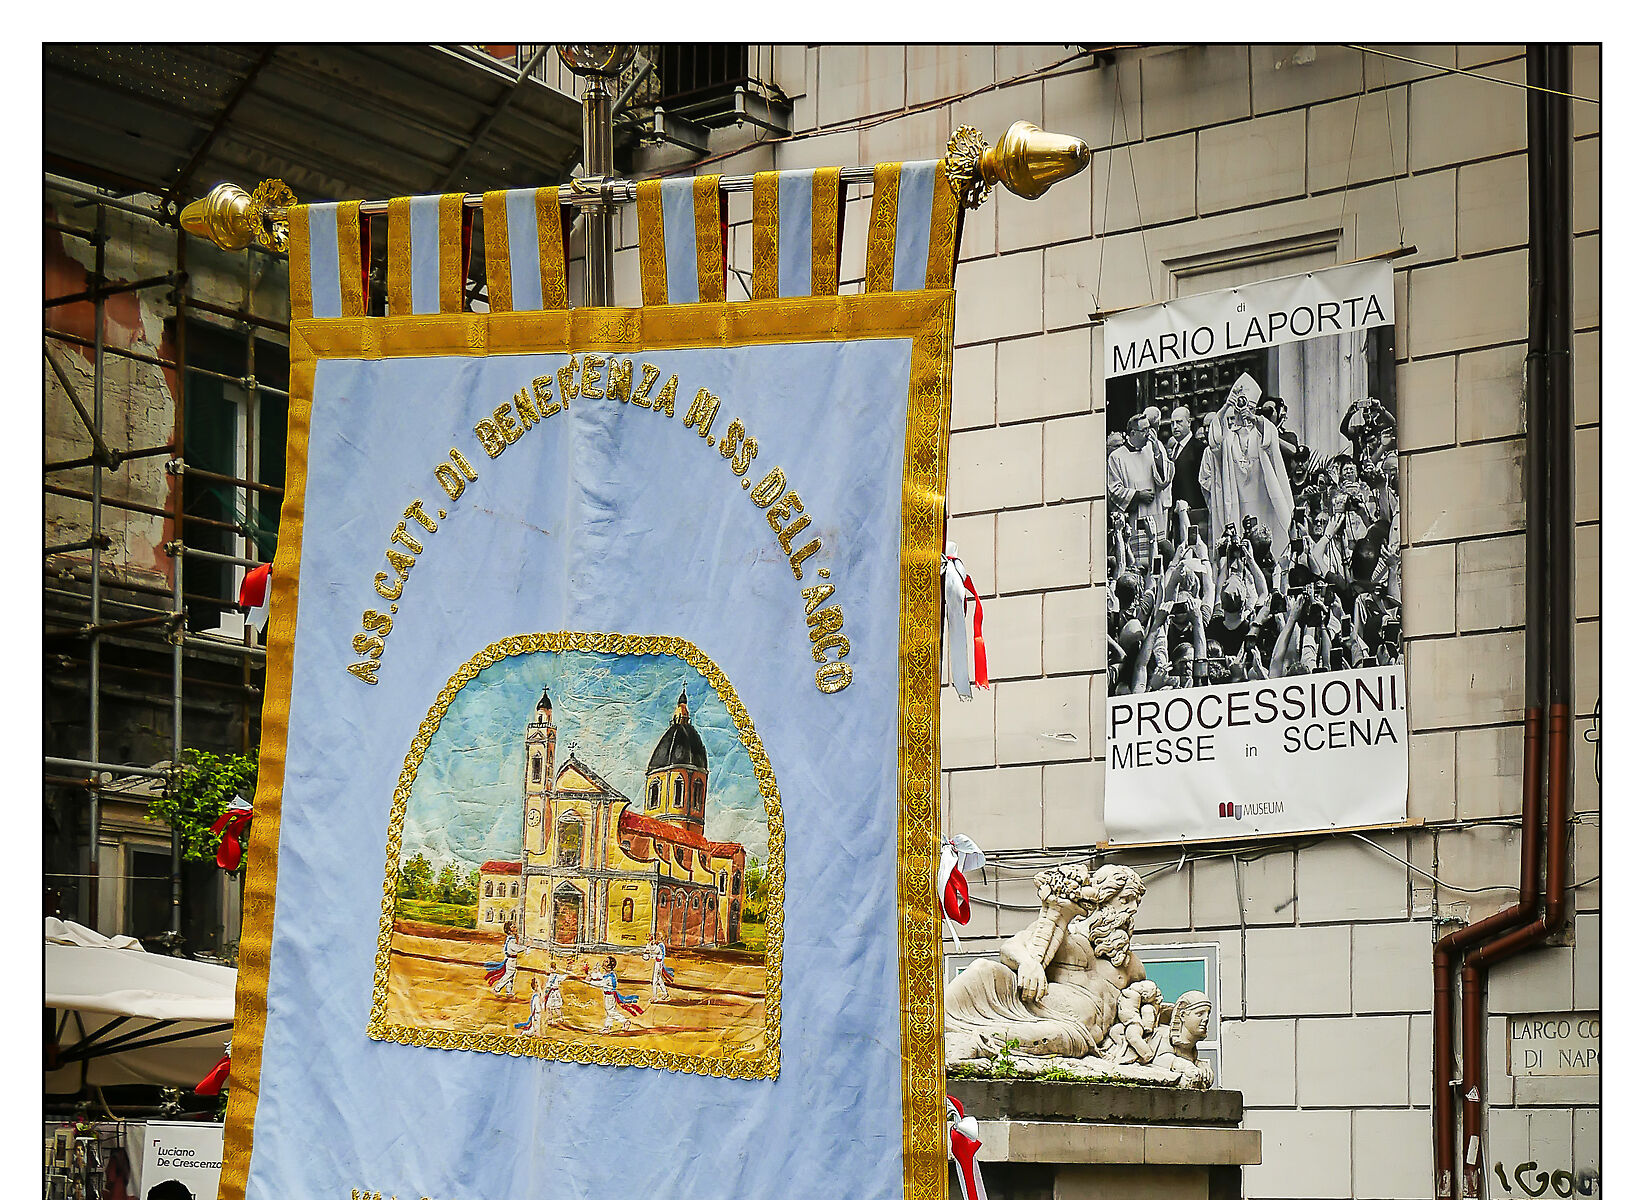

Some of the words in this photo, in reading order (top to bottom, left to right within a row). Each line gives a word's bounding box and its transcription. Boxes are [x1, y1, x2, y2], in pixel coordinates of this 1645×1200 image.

[1236, 302, 1246, 313] di
[1113, 326, 1215, 373] MARIO
[1226, 294, 1386, 350] LAPORTA
[1111, 674, 1398, 739] PROCESSIONI
[1111, 734, 1216, 770] MESSE
[1245, 743, 1258, 758] in
[1283, 717, 1399, 754] SCENA
[1244, 801, 1285, 816] MUSEUM
[1512, 1021, 1571, 1040] LARGO
[1525, 1049, 1542, 1068] DI
[1559, 1048, 1599, 1068] NAP
[158, 1147, 195, 1157] Luciano
[157, 1158, 170, 1167] De
[172, 1158, 222, 1169] Crescenzo
